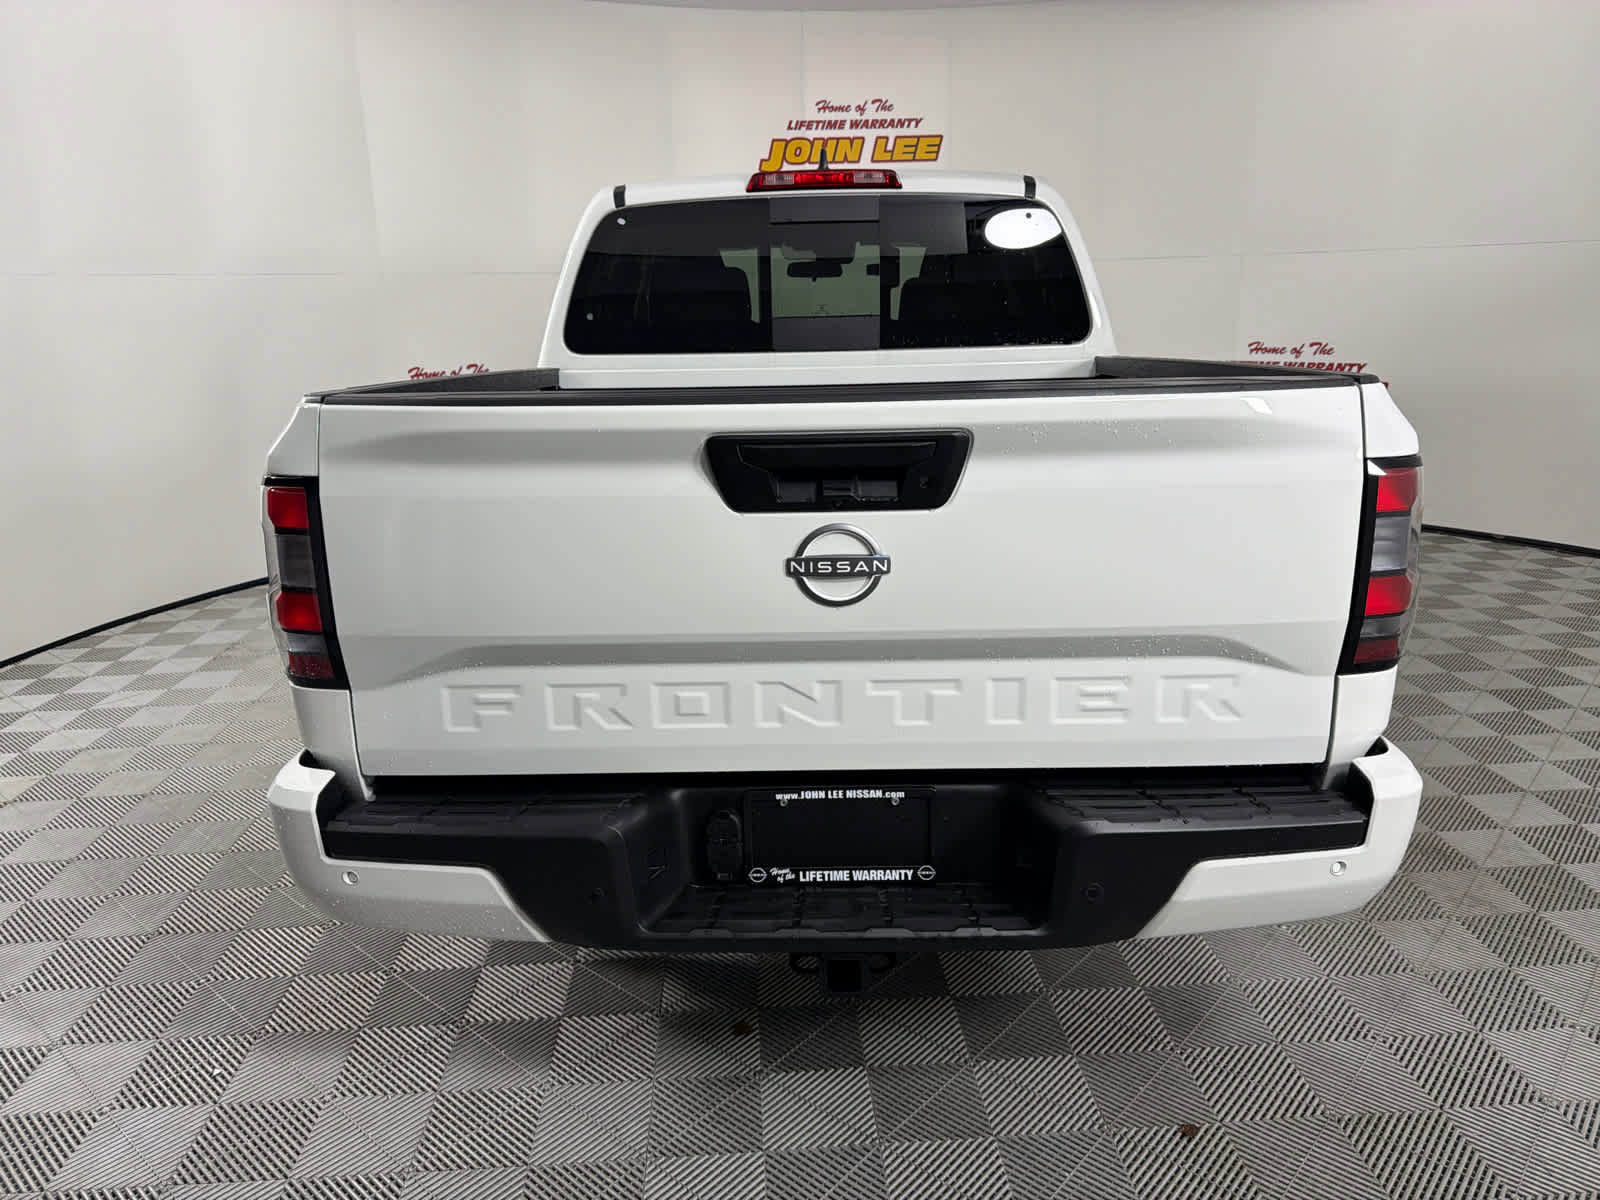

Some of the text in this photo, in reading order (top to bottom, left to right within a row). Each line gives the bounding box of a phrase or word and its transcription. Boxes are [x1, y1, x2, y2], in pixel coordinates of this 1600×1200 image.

[815, 98, 894, 116] Home of The
[787, 118, 923, 131] LIFETIME WARRANTY
[759, 134, 943, 172] JOHN LEE
[1248, 341, 1334, 358] Home of The
[789, 559, 888, 573] NISSAN
[440, 673, 1243, 733] FRONTIER
[828, 789, 844, 799] LEE
[846, 788, 905, 799] NISSAN.com
[799, 870, 850, 882] LIFETIME
[852, 869, 914, 881] WARRANTY
